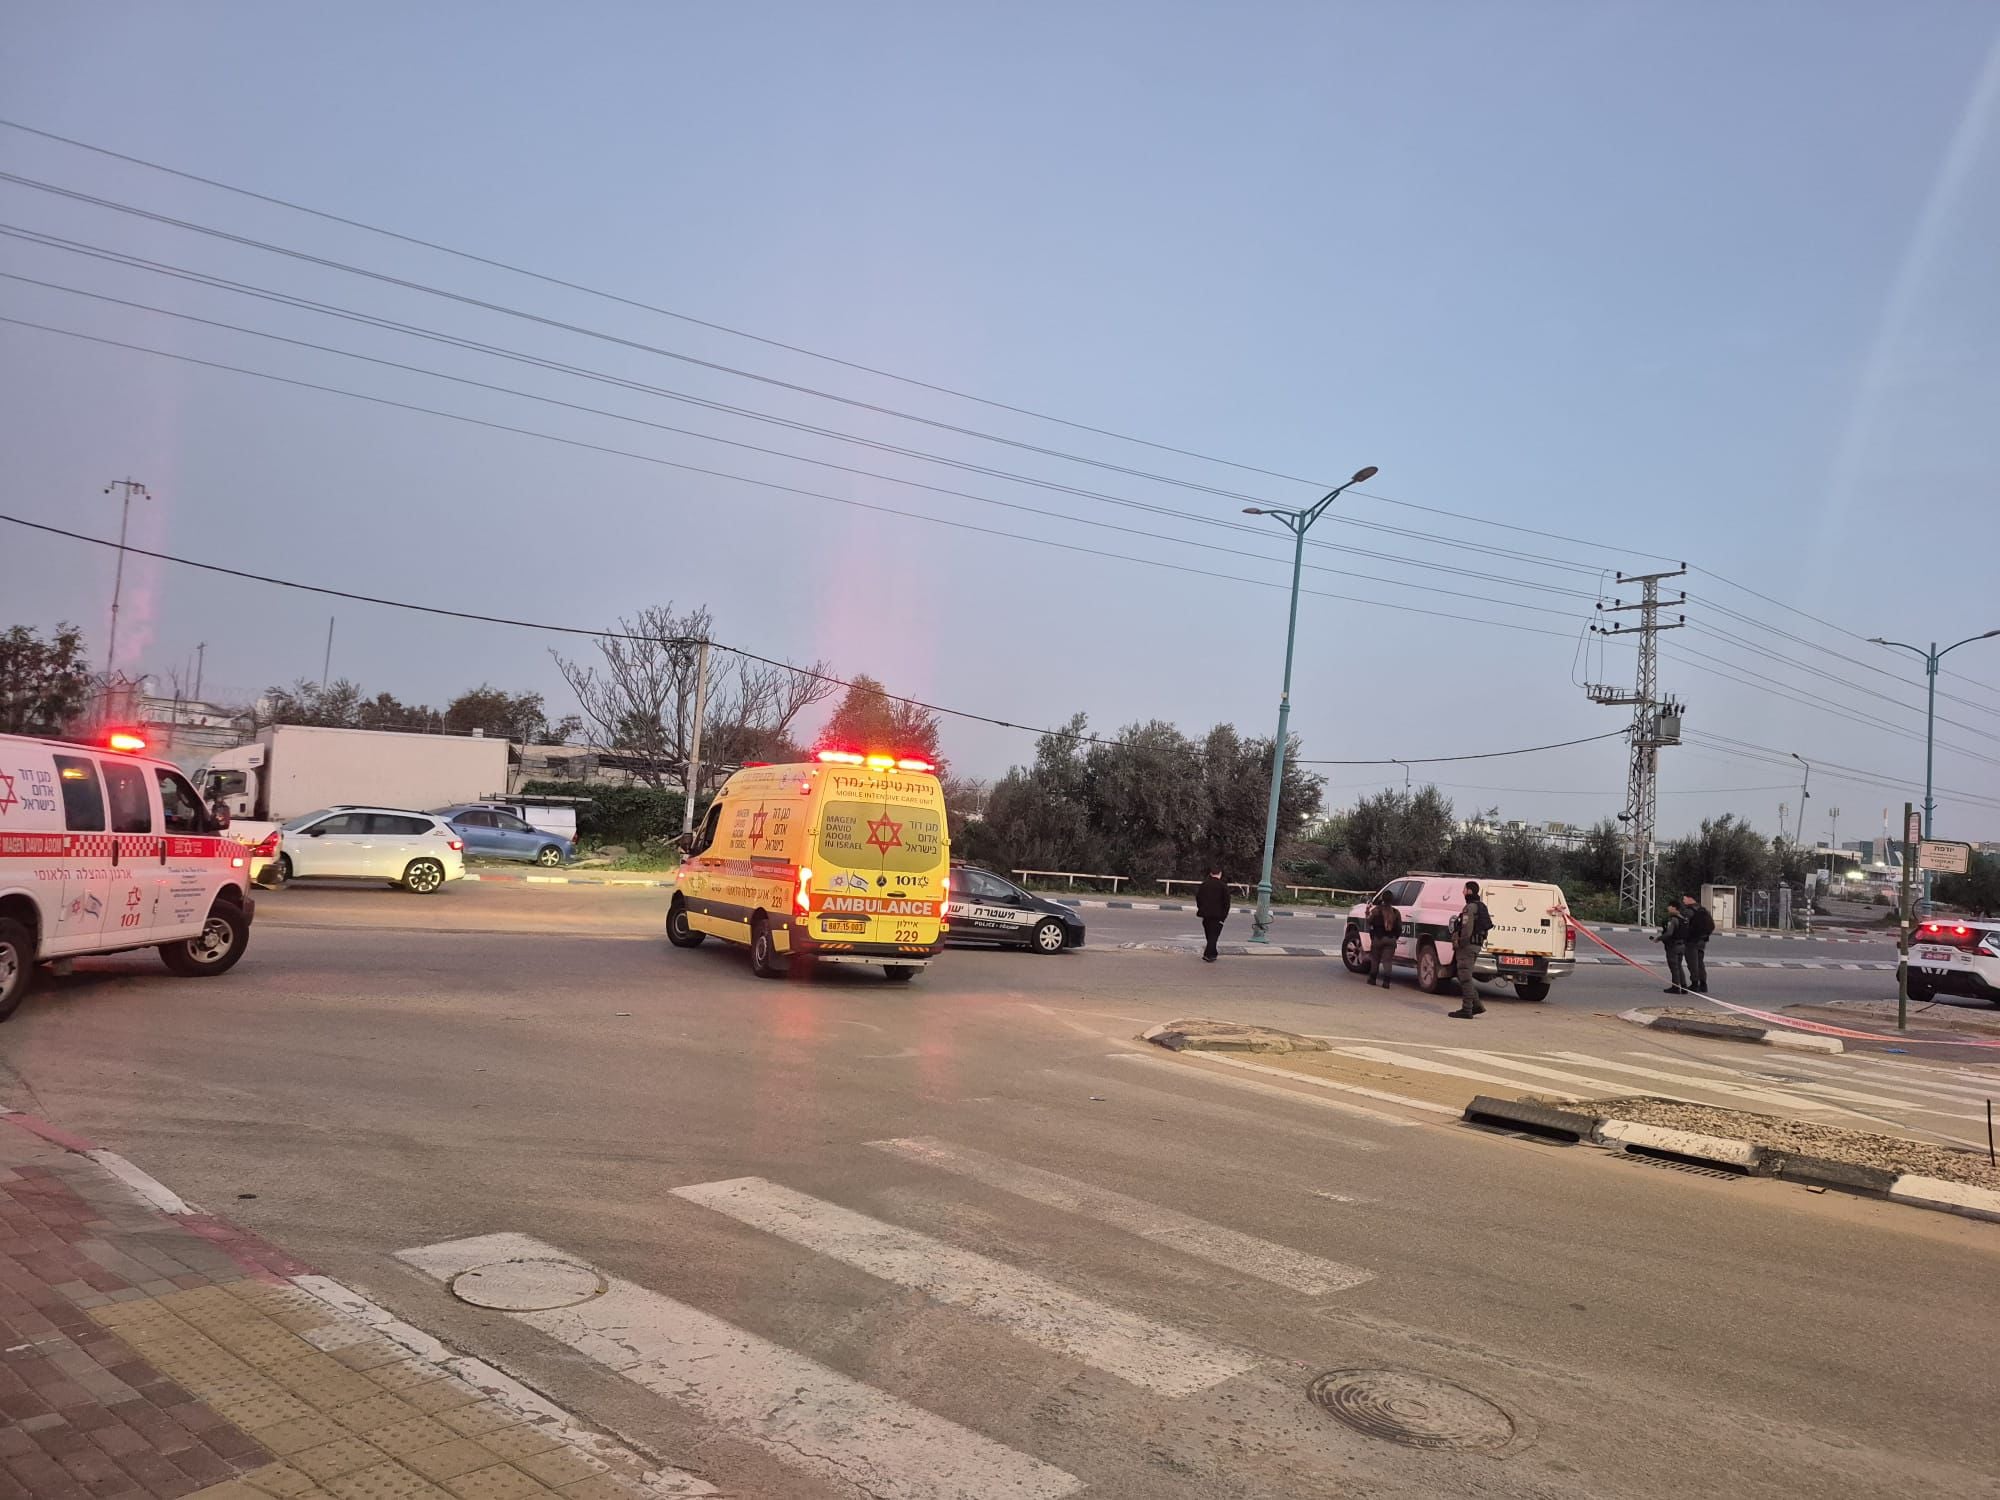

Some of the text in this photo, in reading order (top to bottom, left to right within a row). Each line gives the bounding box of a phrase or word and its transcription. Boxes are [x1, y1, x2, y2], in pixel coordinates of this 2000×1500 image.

[18, 769, 51, 783] מגן דוד
[32, 784, 54, 796] אדום
[833, 776, 934, 795] ניידת טיפול נמרץ
[837, 790, 863, 798] MOBILE
[864, 792, 899, 801] INTENSIVE
[901, 795, 918, 803] CARE
[20, 796, 56, 811] בישראל
[826, 815, 857, 824] MAGEN
[773, 823, 788, 835] אדום
[826, 823, 852, 832] DAVID
[909, 820, 939, 832] מגן דוד
[825, 832, 852, 840] ADOM
[918, 833, 938, 843] אדום
[765, 836, 784, 851] בישראל
[824, 840, 863, 850] IN ISRAEL
[905, 841, 937, 854] בישראל
[34, 867, 132, 881] ארגון ההצלה הלאומי
[896, 875, 917, 886] 101
[771, 896, 782, 908] 229
[822, 896, 933, 915] AMBULANCE
[974, 907, 1015, 919] משטרת
[120, 913, 140, 927] 101
[897, 919, 918, 929] איילון
[974, 920, 996, 928] POLICE
[895, 930, 918, 942] 229
